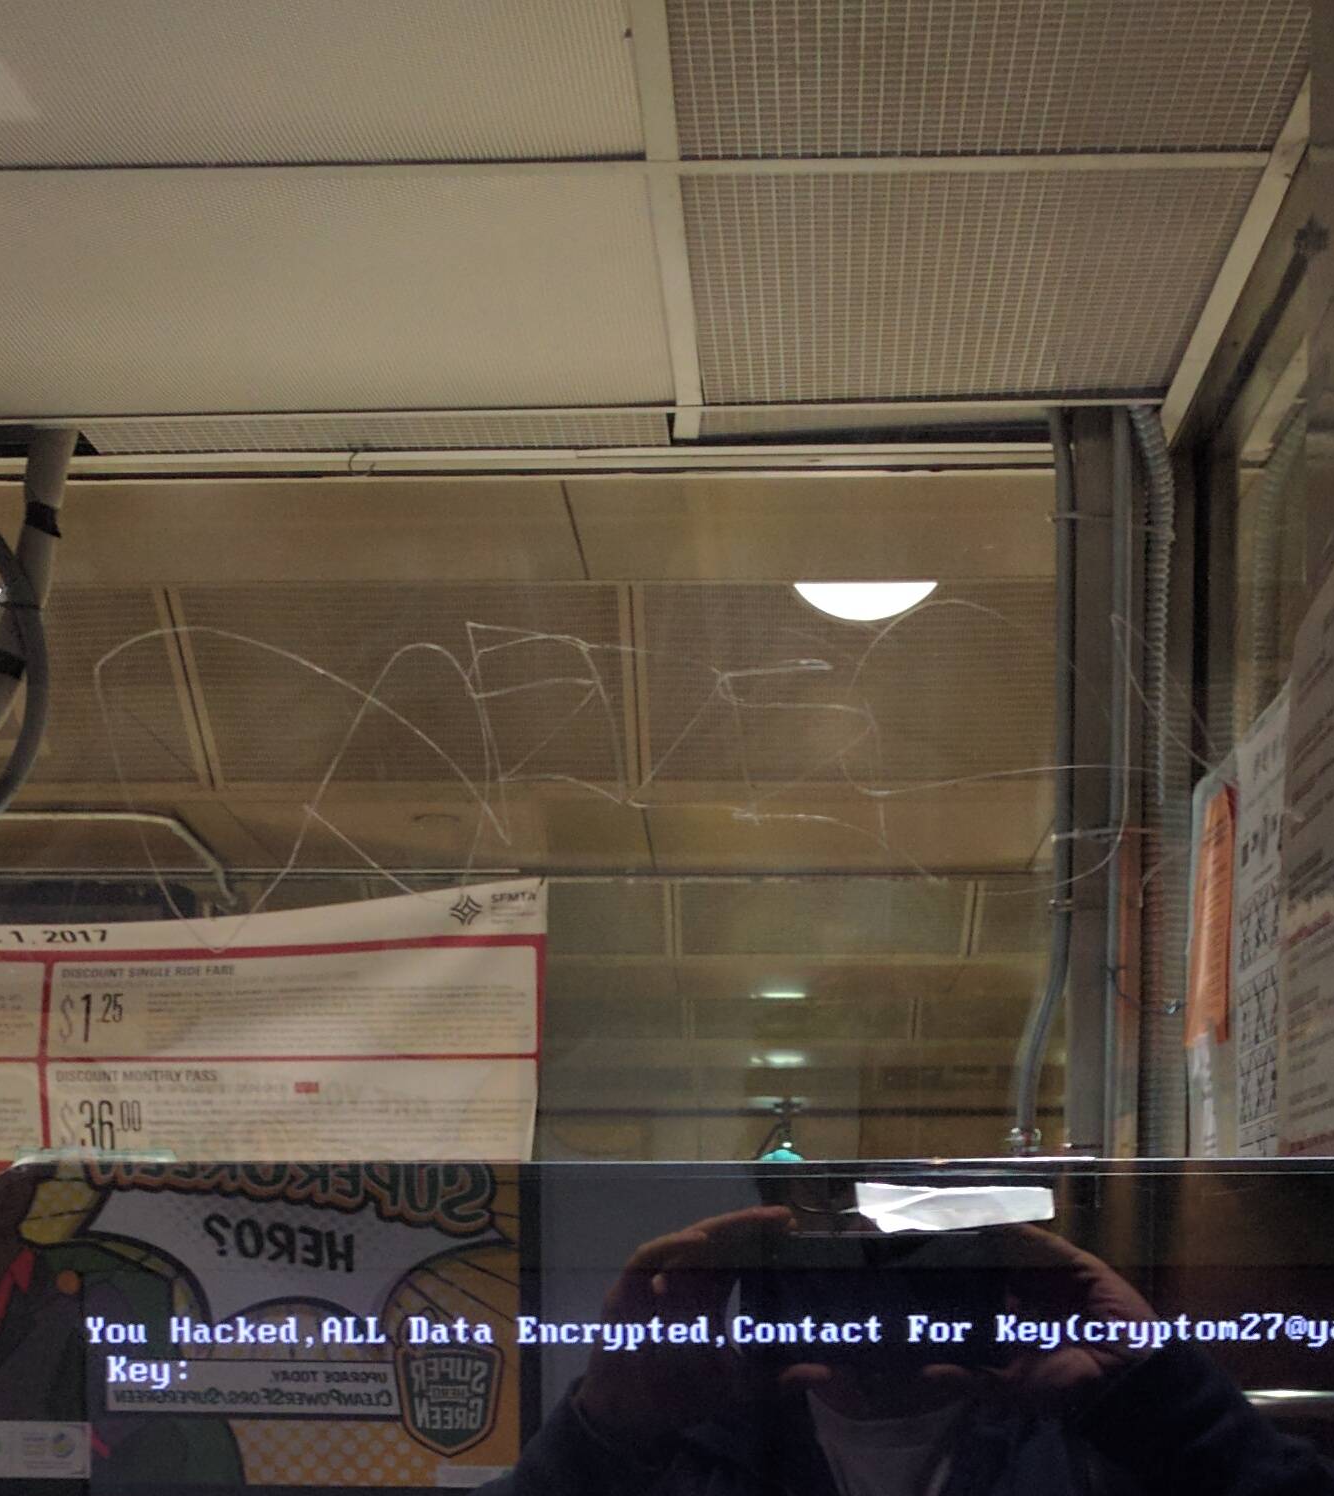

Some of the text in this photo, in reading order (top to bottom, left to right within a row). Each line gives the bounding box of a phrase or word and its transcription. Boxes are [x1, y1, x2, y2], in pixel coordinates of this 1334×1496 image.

[43, 929, 107, 943] 2017
[61, 964, 235, 979] DISCOUNT SINGLE RIDE FARE
[59, 993, 124, 1042] $1.25
[56, 1070, 218, 1082] DISCOUNT MONTHLY PASS
[84, 1317, 155, 1346] You
[169, 1315, 386, 1350] Hacked,ALL
[409, 1318, 494, 1346] Data
[516, 1316, 884, 1351] Encrypted,Contact
[908, 1317, 973, 1346] For
[107, 1355, 191, 1389] Key:
